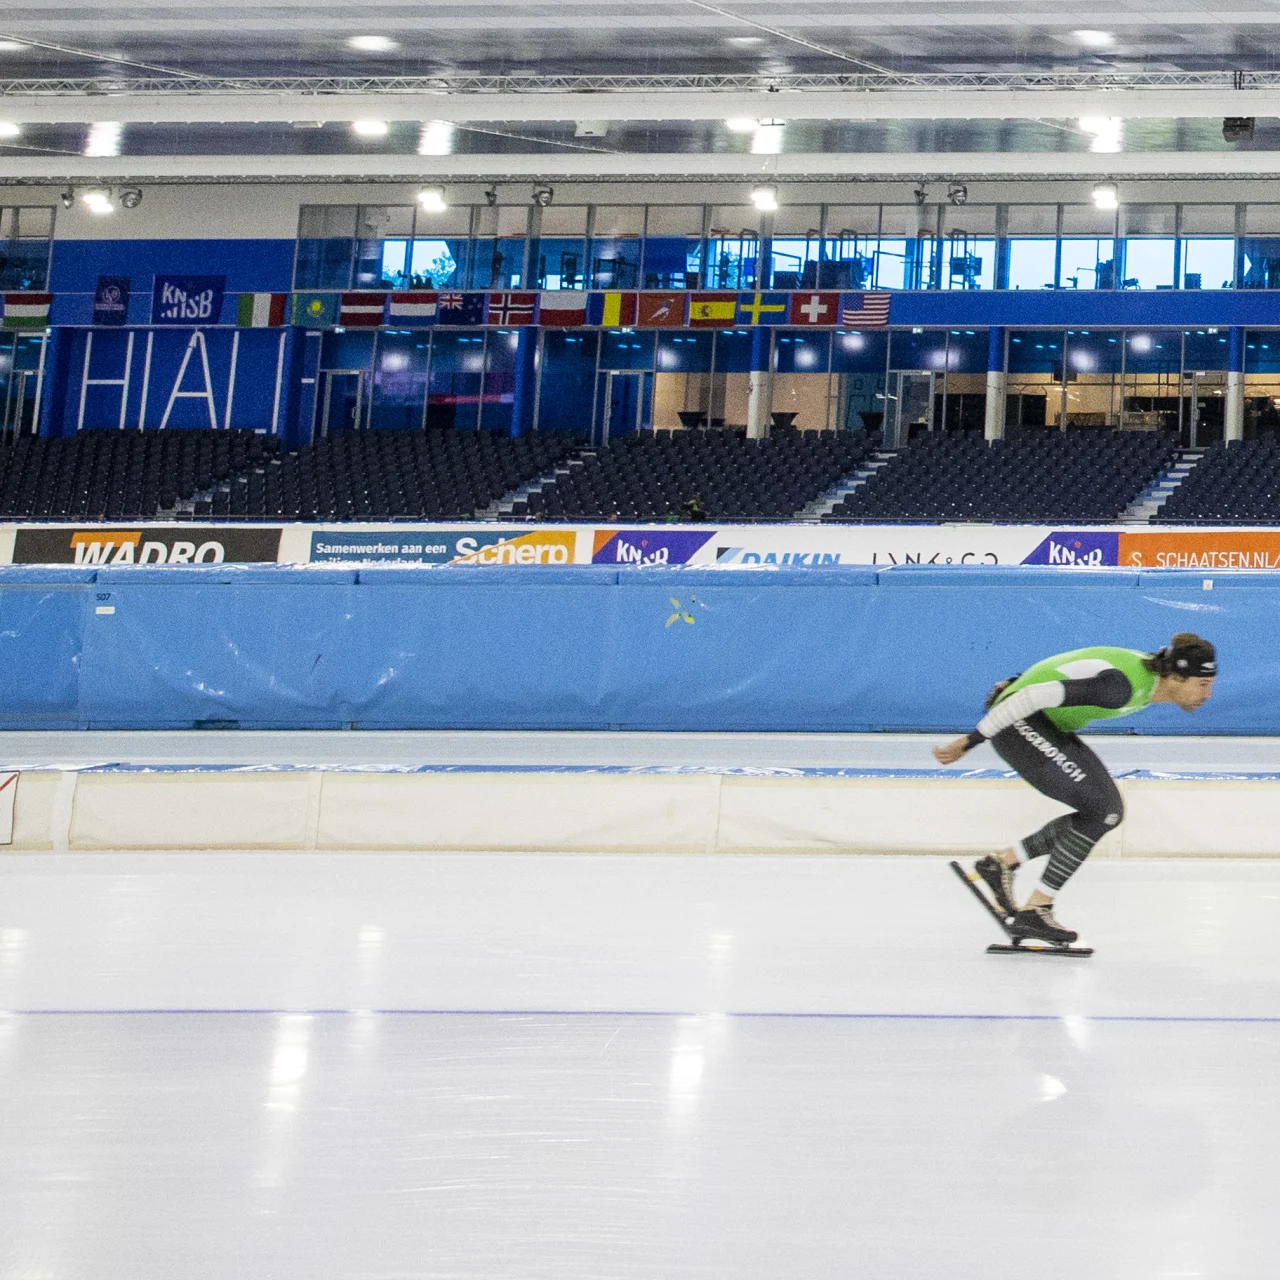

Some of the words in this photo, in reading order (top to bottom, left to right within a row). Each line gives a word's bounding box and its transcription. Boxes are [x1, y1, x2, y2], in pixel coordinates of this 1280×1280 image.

[316, 543, 398, 554] Samenwerken
[401, 545, 422, 554] aan
[425, 545, 447, 554] een
[454, 538, 569, 565] Scherp
